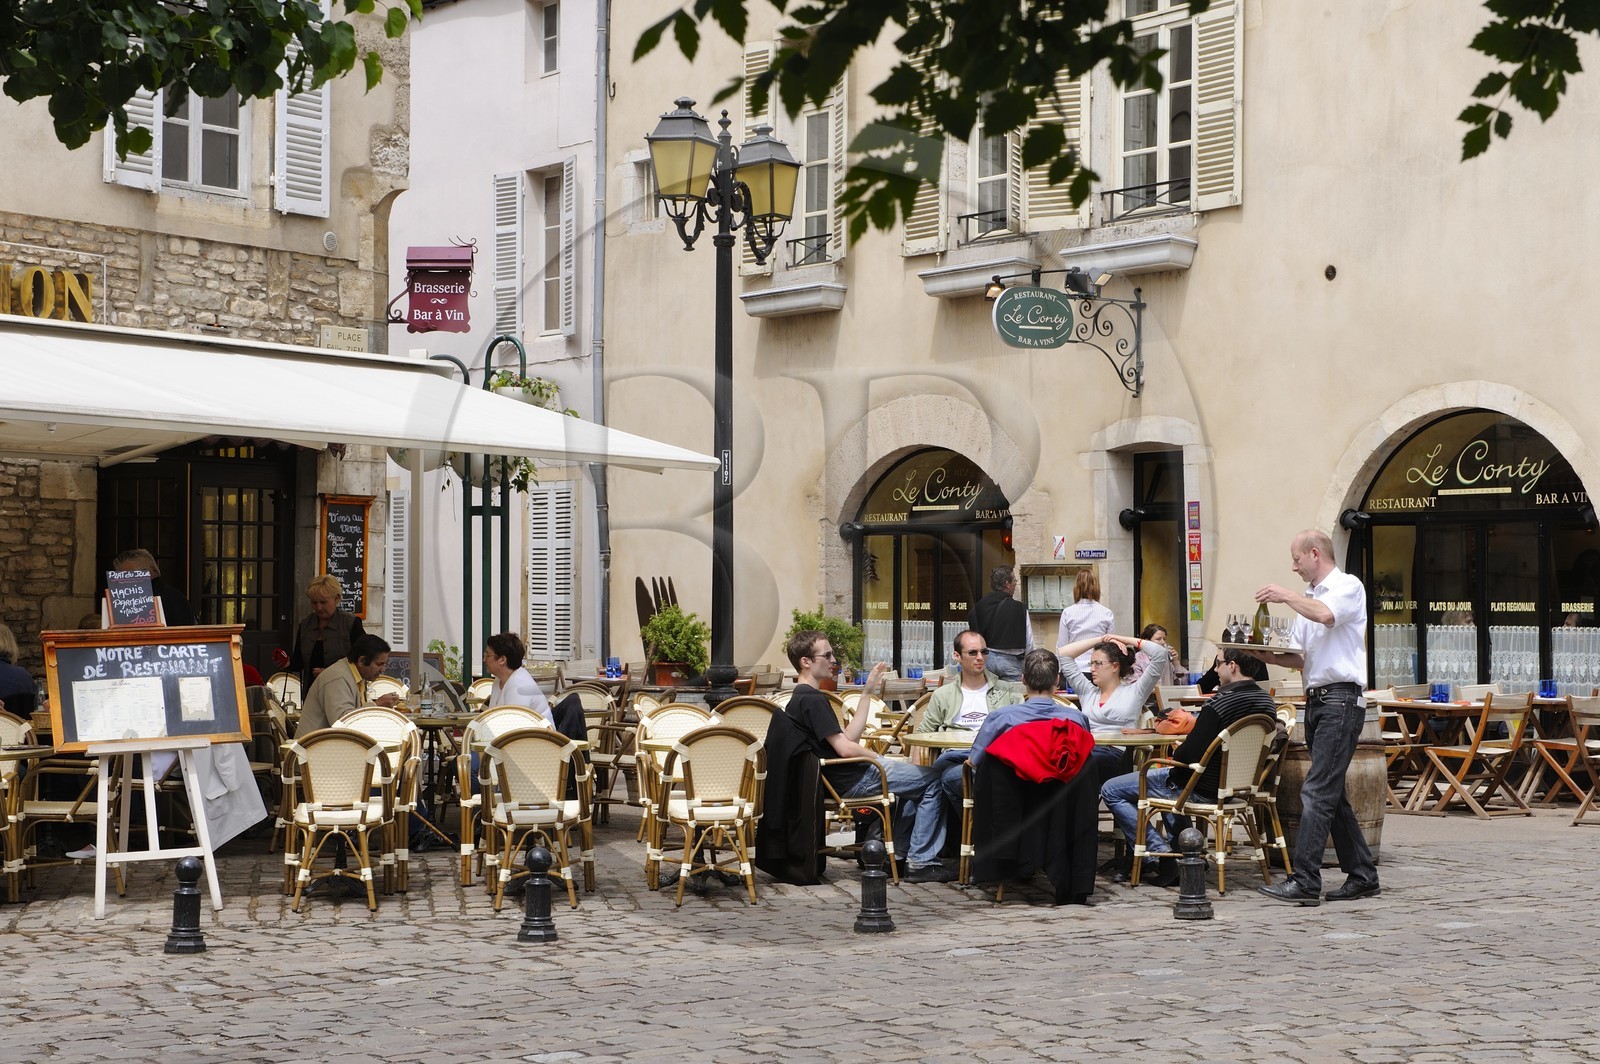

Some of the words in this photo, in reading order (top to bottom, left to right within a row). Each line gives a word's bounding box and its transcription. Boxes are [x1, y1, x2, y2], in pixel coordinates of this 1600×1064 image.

[413, 282, 465, 293] Brasserie
[1013, 291, 1057, 302] RESTAURANT
[413, 309, 433, 320] Bar
[435, 309, 442, 320] à
[445, 310, 464, 320] Vin
[1003, 304, 1025, 324] Le
[1027, 304, 1068, 331] Conty
[337, 331, 362, 342] PLACE
[1018, 335, 1032, 346] BAR
[1040, 336, 1055, 346] VINS
[1406, 443, 1448, 487] Le
[1456, 439, 1550, 494] Conty
[892, 469, 920, 503] Le
[924, 467, 984, 510] Conty
[1369, 496, 1437, 510] RESTAURANT
[1535, 492, 1559, 505] BAR
[1561, 492, 1570, 503] A
[864, 512, 908, 522] RESTAURANT
[975, 509, 990, 519] BAR
[991, 510, 997, 519] A
[1382, 601, 1394, 611] VIN
[1394, 600, 1404, 611] AU
[1429, 601, 1447, 611] PLATS
[1447, 601, 1456, 611] DU
[1456, 601, 1472, 611] JOUR
[1490, 602, 1506, 612] PLATS
[1506, 602, 1536, 612] REGIONAUX
[1561, 602, 1595, 613] BRASSERIE
[96, 645, 143, 663] NOTRE
[157, 644, 209, 659] CARTE
[83, 664, 107, 679] DE
[120, 656, 223, 678] RESTAURANT
